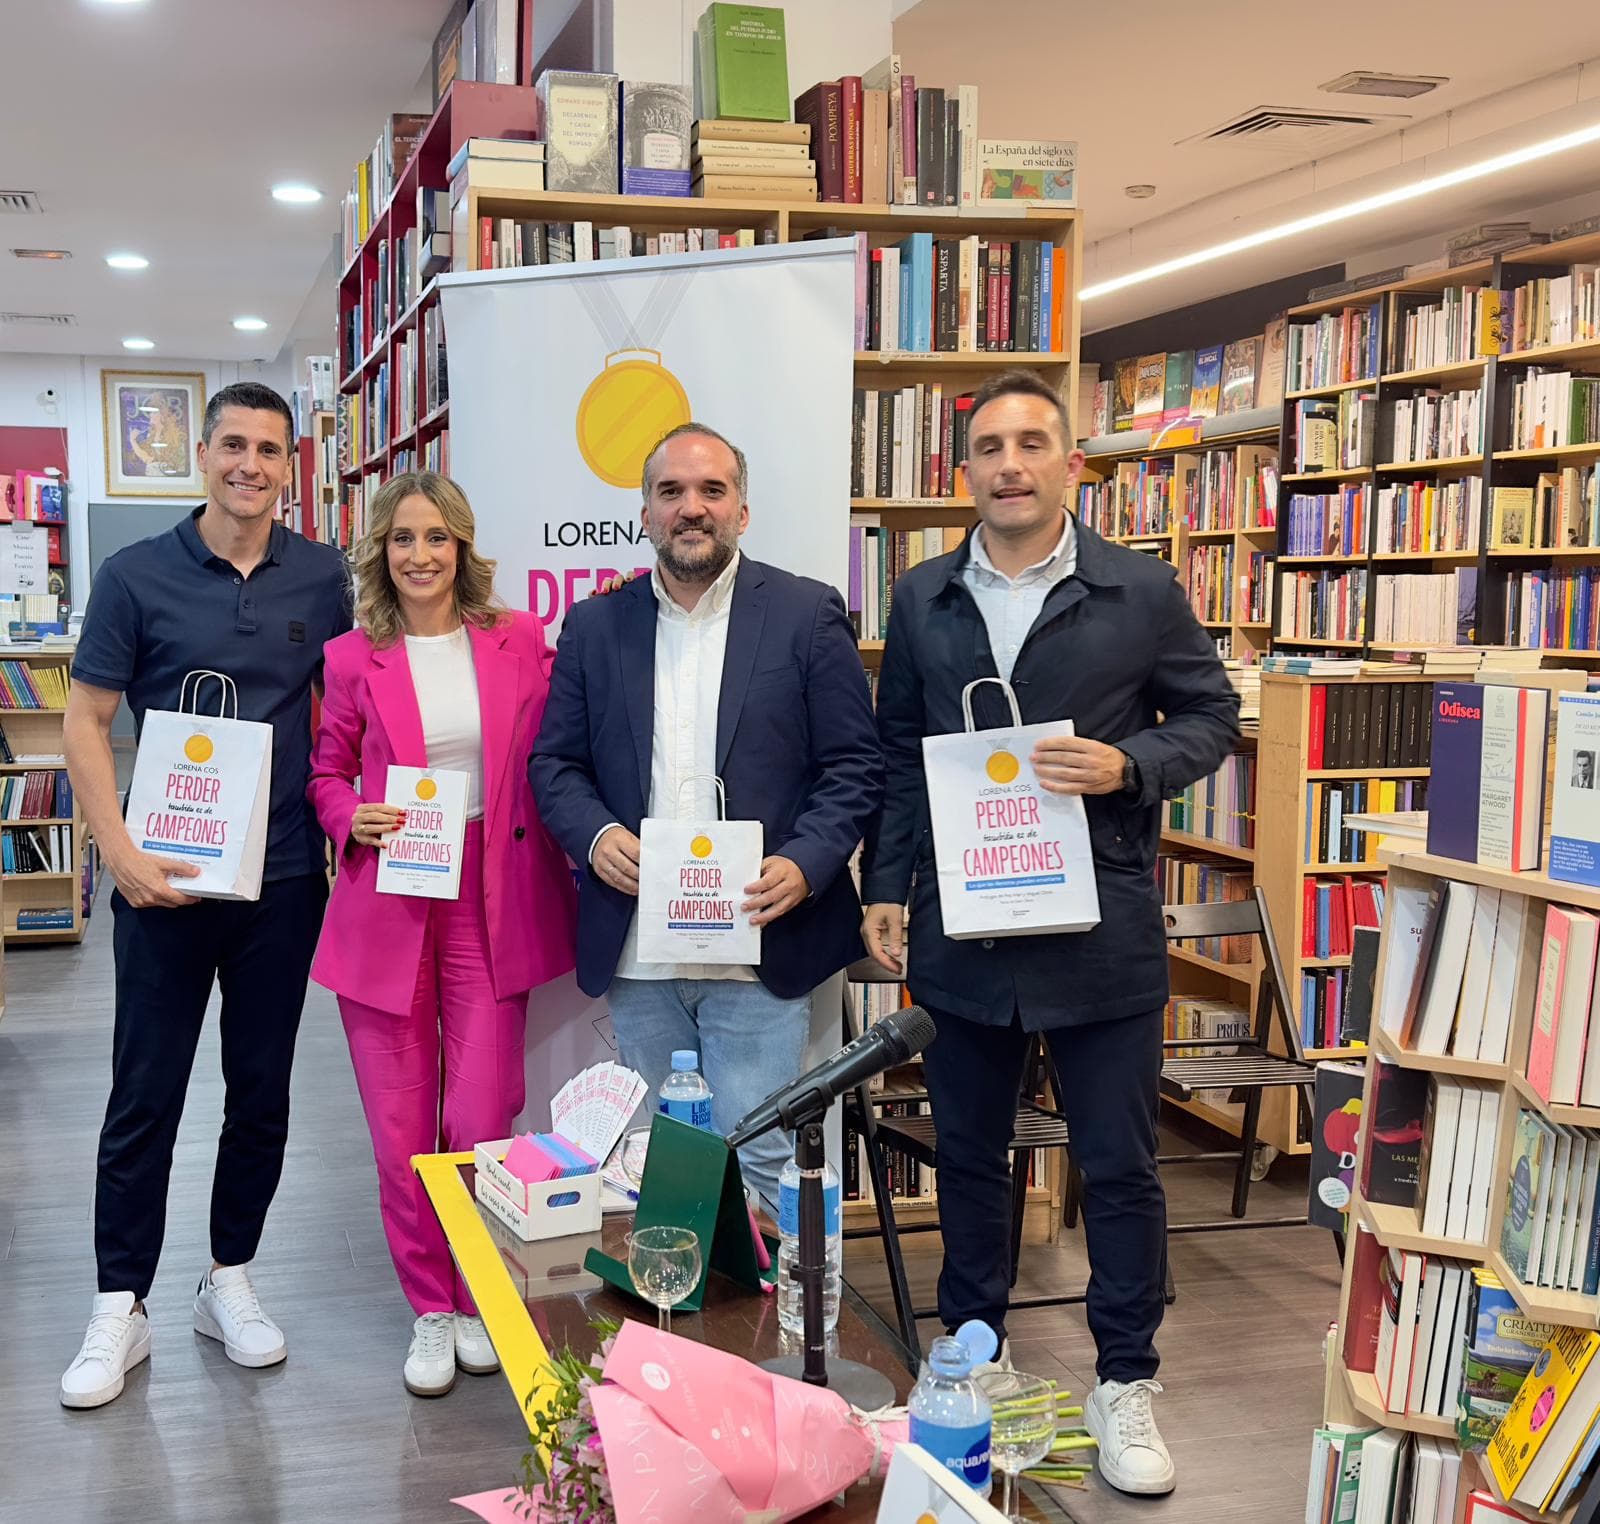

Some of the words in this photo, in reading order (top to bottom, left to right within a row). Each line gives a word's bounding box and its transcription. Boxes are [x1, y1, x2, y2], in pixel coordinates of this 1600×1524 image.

[828, 91, 838, 142] POMPEYA
[983, 144, 993, 154] La
[995, 144, 1026, 157] España
[1028, 144, 1041, 155] del
[1043, 145, 1061, 158] siglo
[1034, 158, 1054, 166] siete
[1055, 158, 1074, 167] días
[1439, 700, 1481, 720] Odisea
[174, 763, 202, 773] LORENA
[204, 766, 219, 774] COS
[166, 773, 221, 803] PERDER
[979, 787, 1012, 797] LORENA
[1014, 784, 1032, 793] COS
[1482, 793, 1511, 802] MARGARET
[168, 803, 194, 813] también
[204, 806, 213, 814] de
[975, 796, 1040, 829] PERDER
[1482, 801, 1506, 809] ATWOOD
[146, 812, 228, 846] CAMPEONES
[404, 809, 443, 831] PERDER
[983, 832, 1014, 842] también
[1026, 829, 1037, 838] de
[388, 839, 451, 864] CAMPEONES
[964, 841, 1064, 877] CAMPEONES
[680, 868, 721, 888] PERDER
[668, 900, 734, 920] CAMPEONES
[1392, 1154, 1405, 1162] LAS
